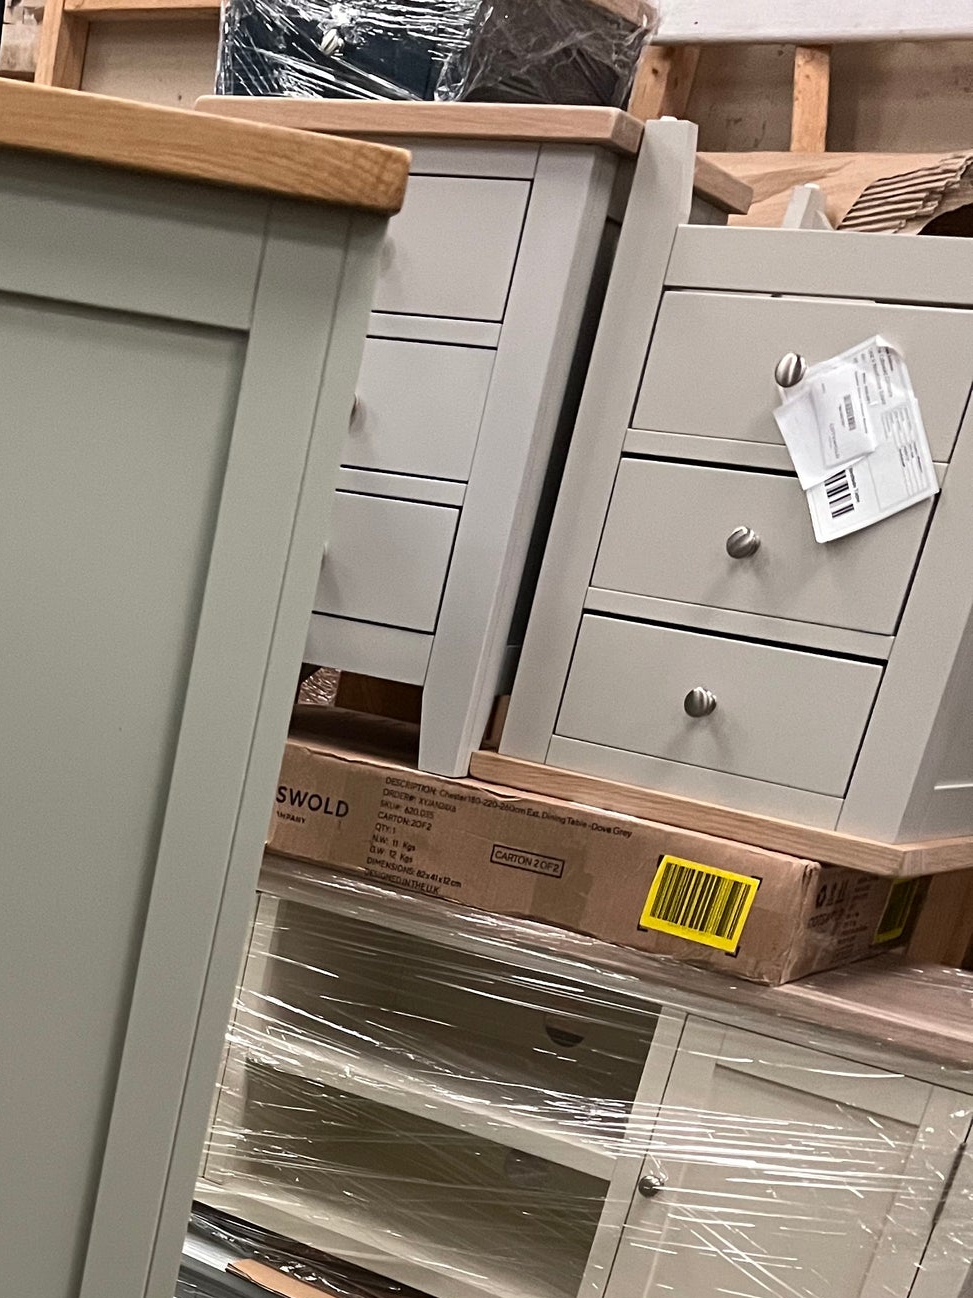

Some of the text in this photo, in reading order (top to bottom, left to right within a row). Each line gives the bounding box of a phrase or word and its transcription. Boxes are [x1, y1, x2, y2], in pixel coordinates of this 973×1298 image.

[275, 785, 349, 818] SWOLD
[612, 827, 632, 839] Grey
[495, 850, 533, 867] CARTON
